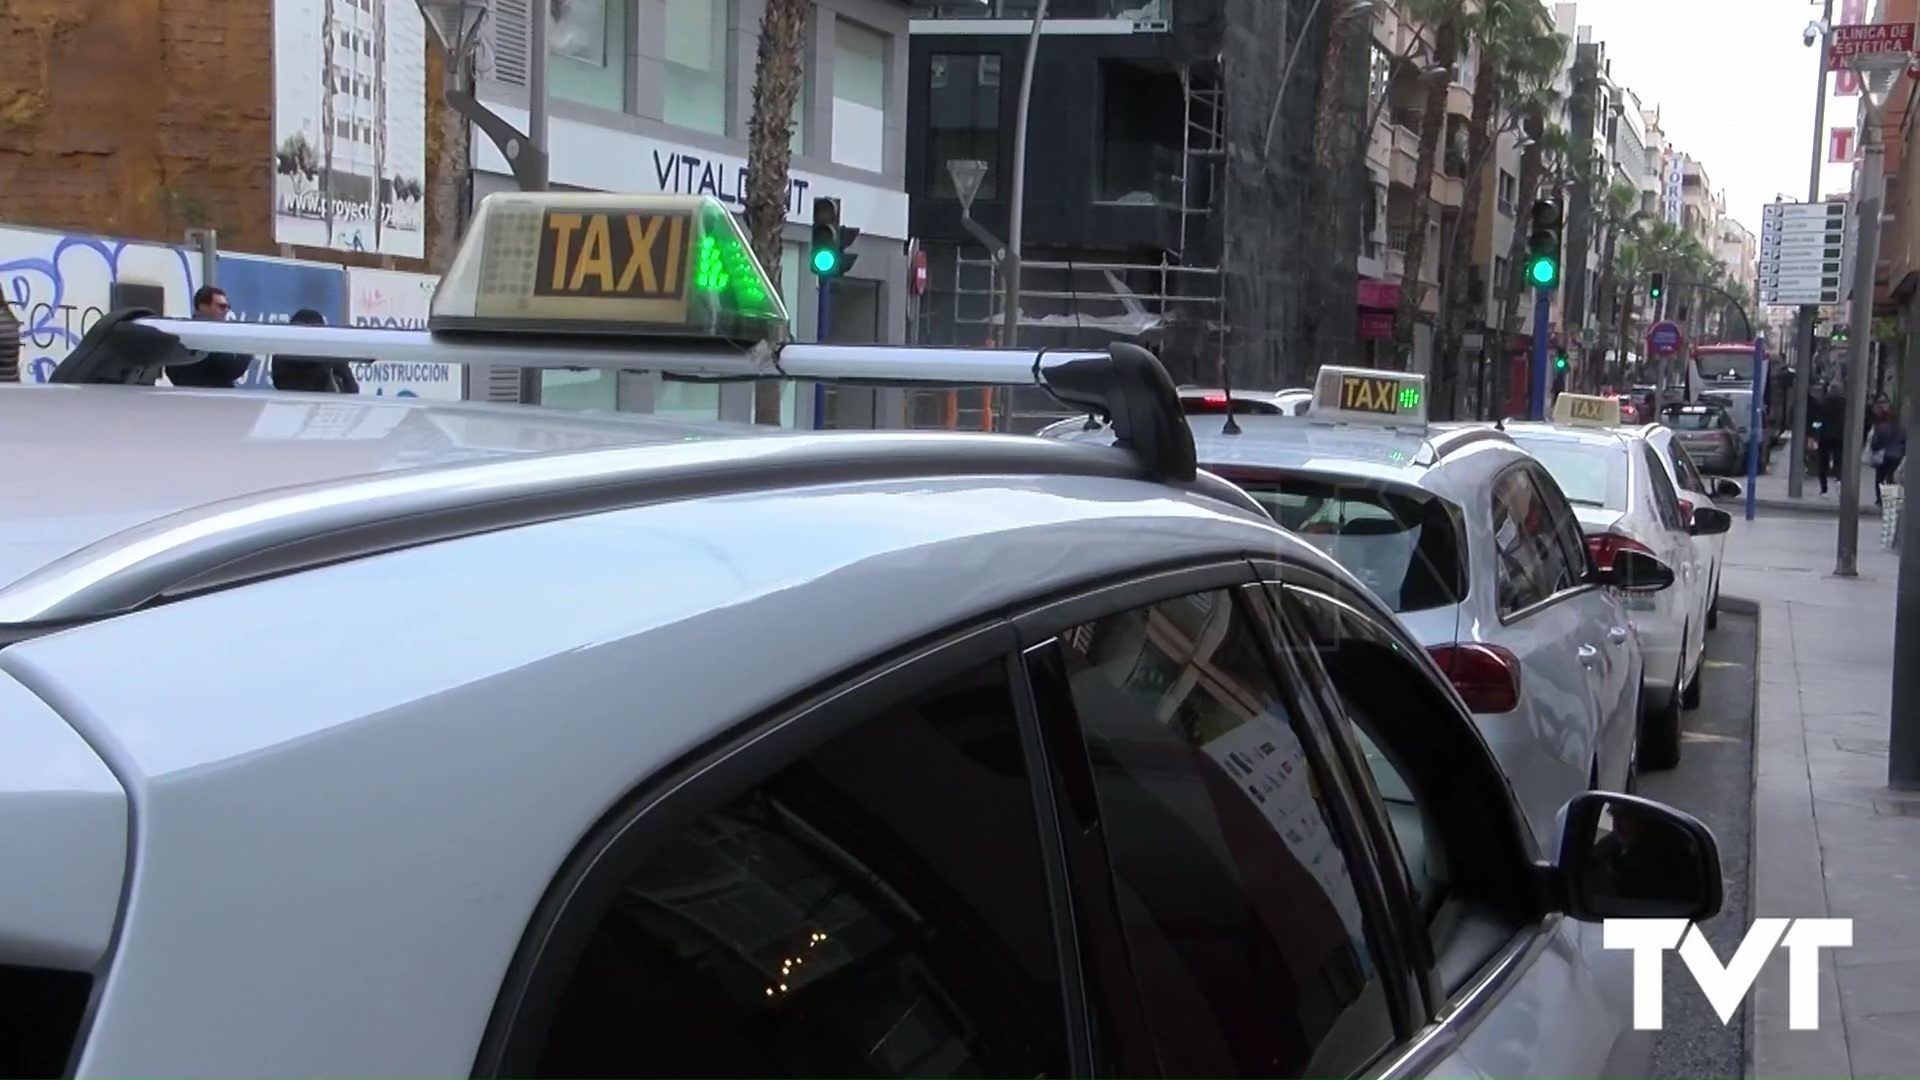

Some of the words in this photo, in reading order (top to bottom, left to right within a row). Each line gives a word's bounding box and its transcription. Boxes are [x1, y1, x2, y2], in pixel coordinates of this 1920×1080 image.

[1890, 25, 1909, 38] DE
[653, 148, 810, 216] VITALDT
[549, 213, 684, 293] TAXI
[1344, 378, 1397, 411] TAXI
[1571, 400, 1602, 419] TAXI
